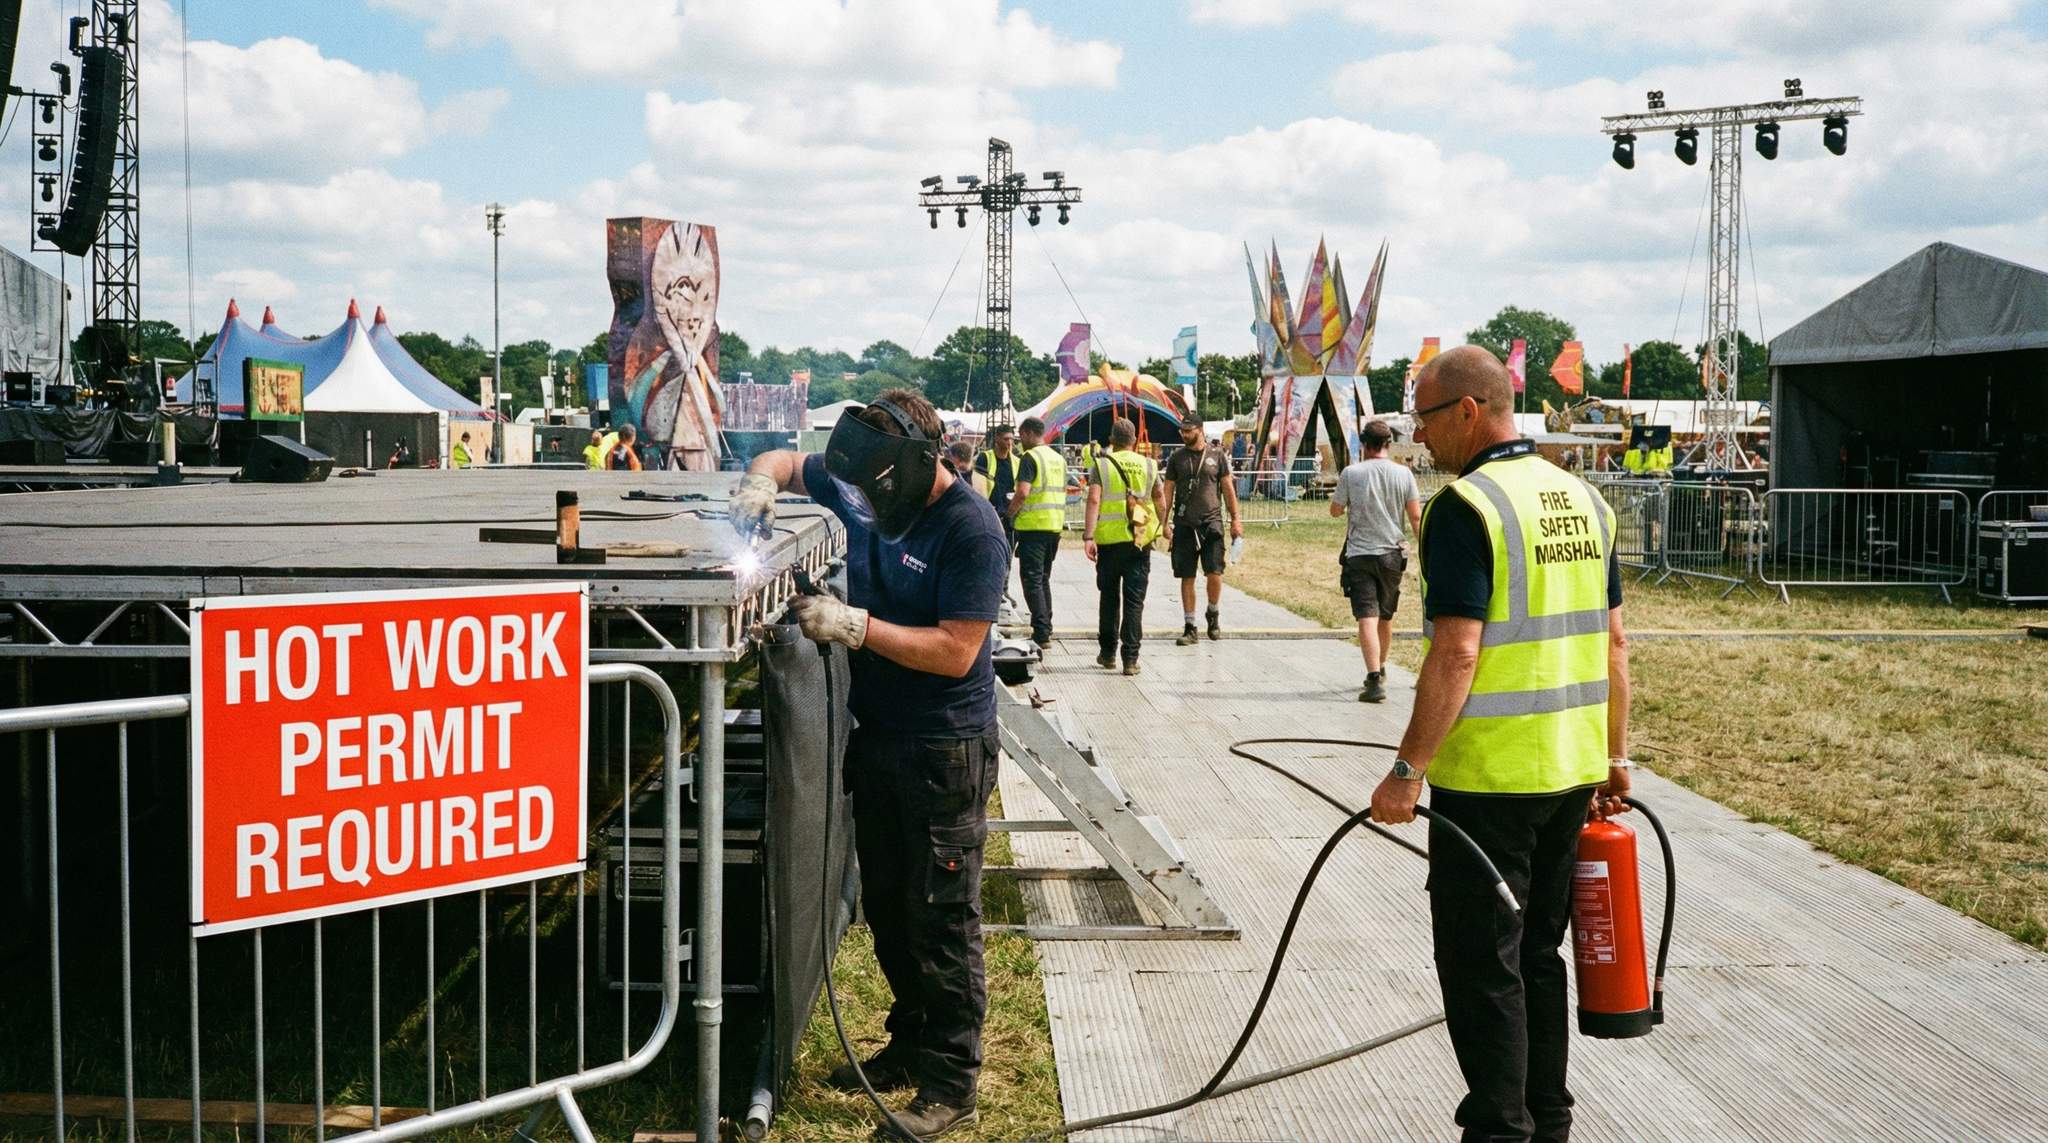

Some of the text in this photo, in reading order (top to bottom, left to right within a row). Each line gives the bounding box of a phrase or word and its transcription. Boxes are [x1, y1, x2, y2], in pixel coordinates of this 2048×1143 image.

[1539, 491, 1572, 511] FIRE
[1540, 515, 1589, 538] SAFETY
[1535, 540, 1601, 565] MARSHAL
[225, 611, 568, 705] HOT WORK
[280, 701, 522, 797] PERMIT
[236, 785, 554, 899] REQUIRED
